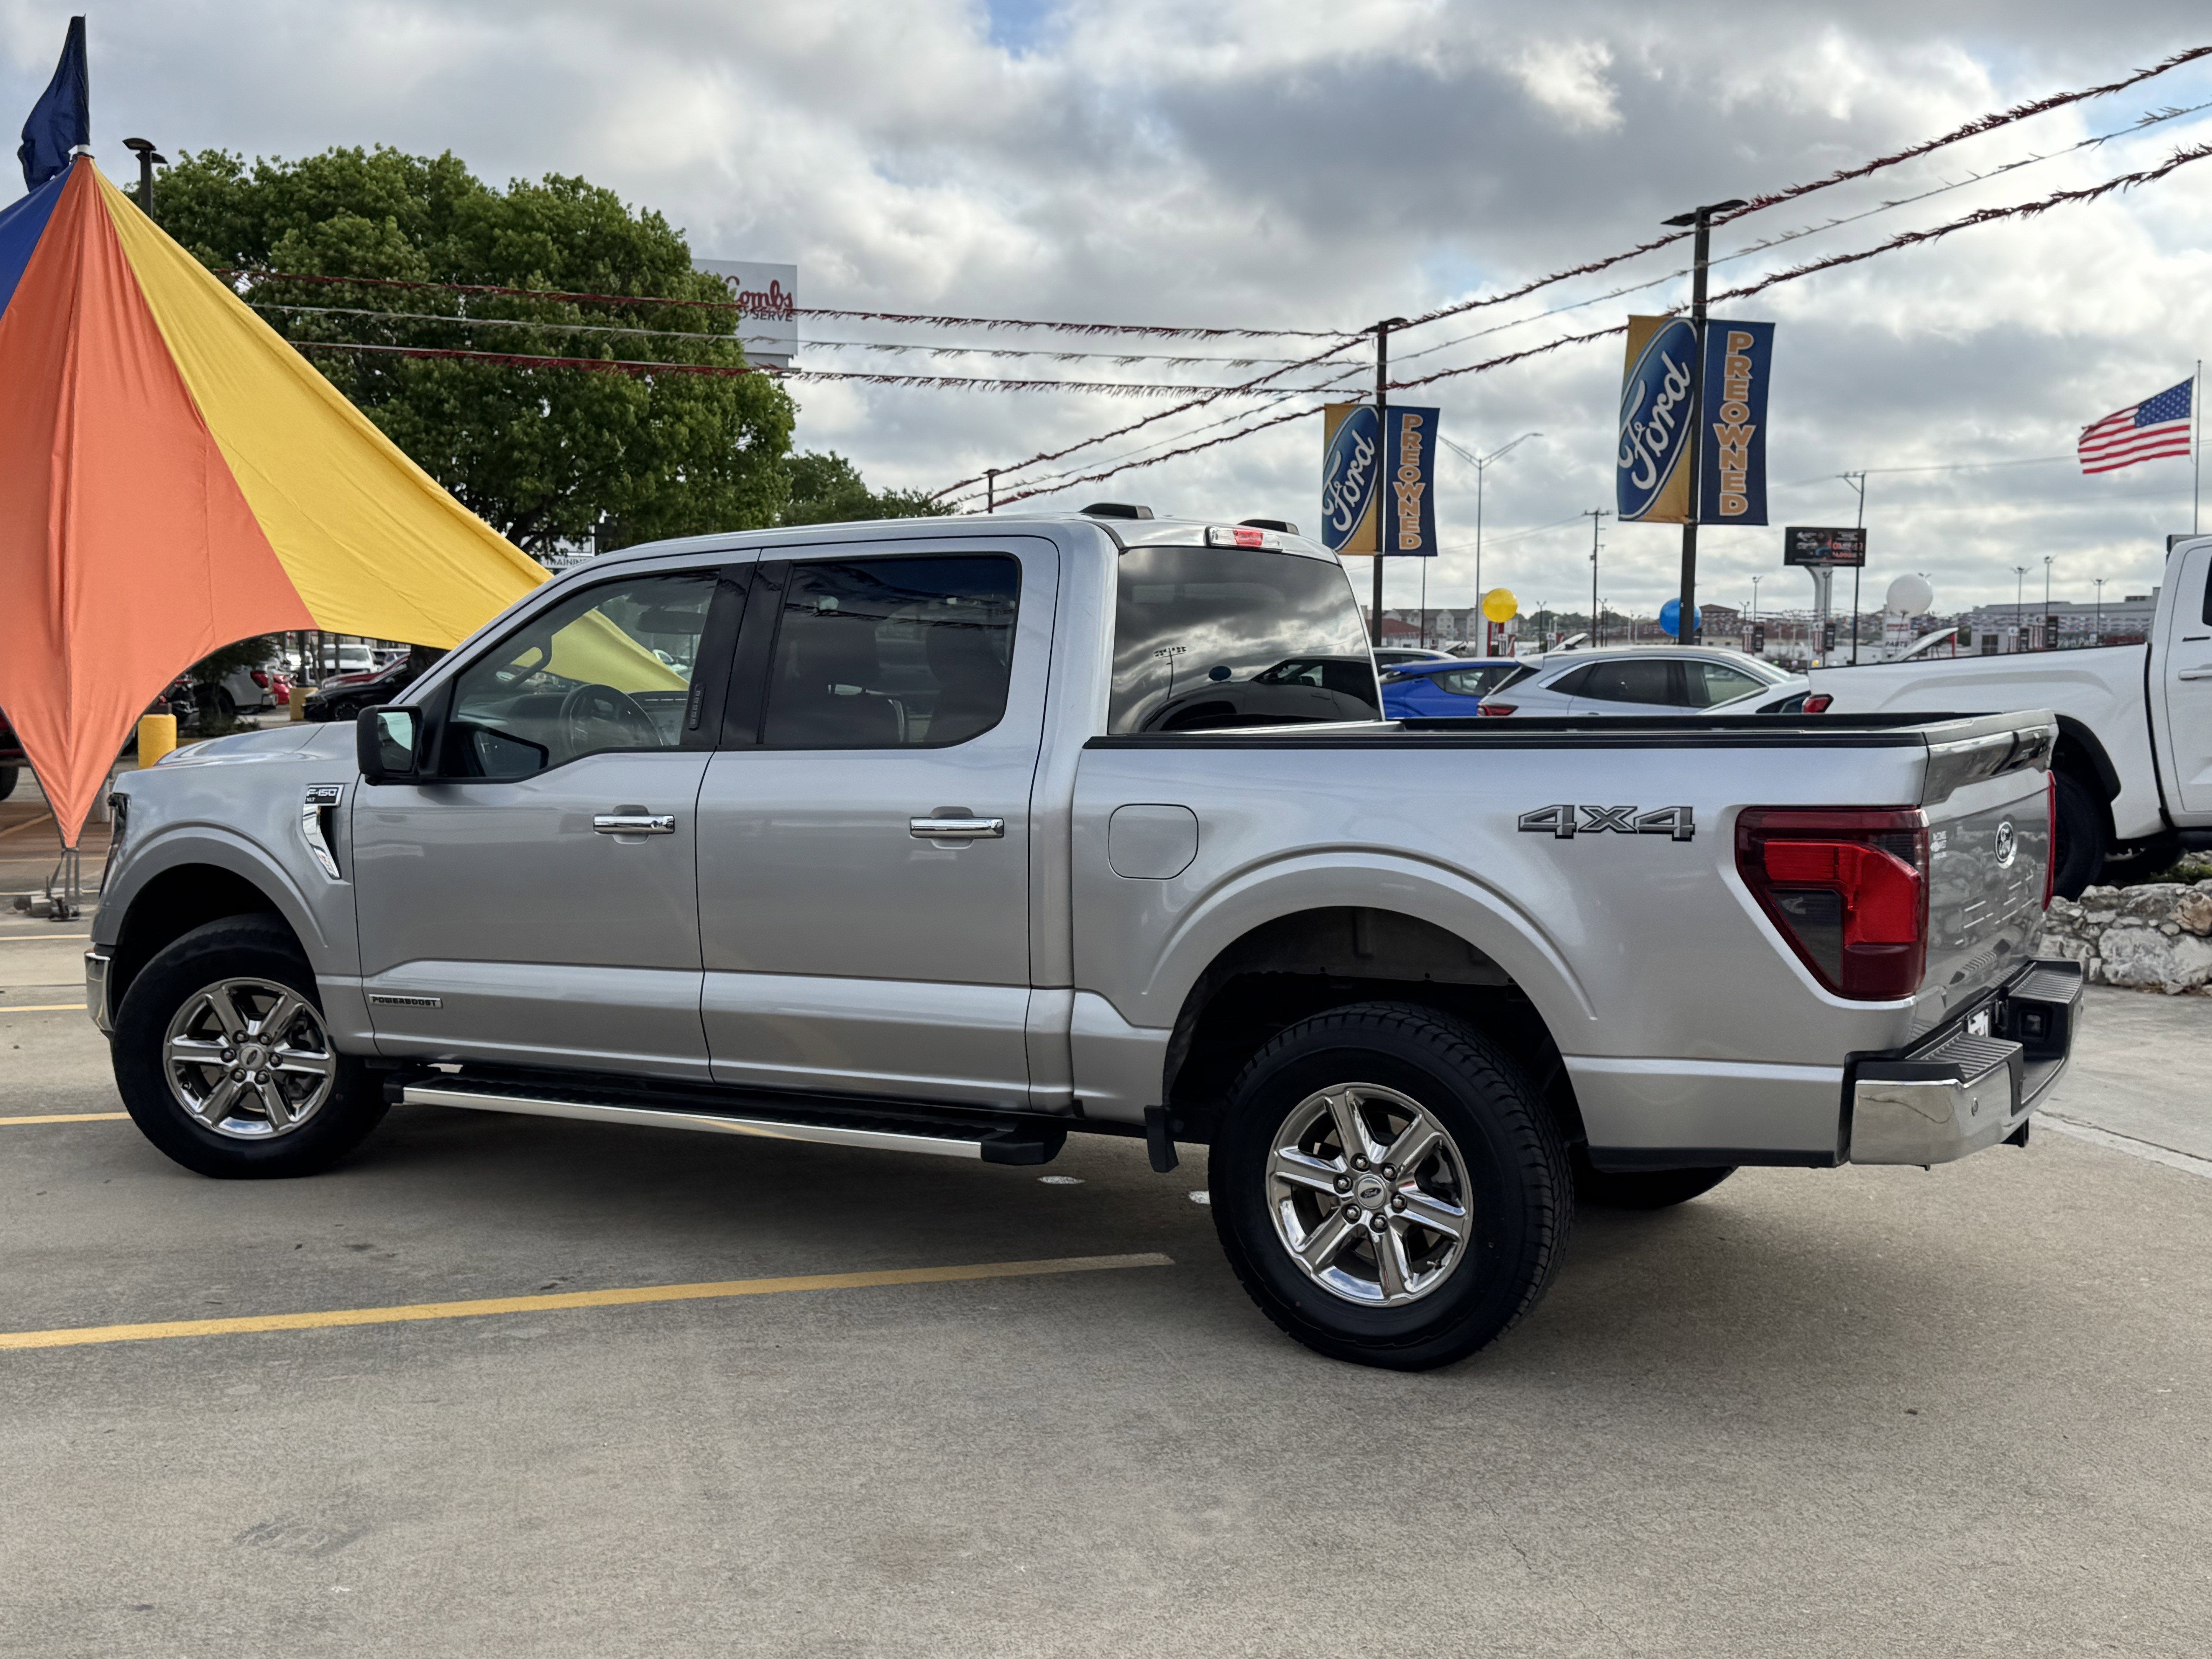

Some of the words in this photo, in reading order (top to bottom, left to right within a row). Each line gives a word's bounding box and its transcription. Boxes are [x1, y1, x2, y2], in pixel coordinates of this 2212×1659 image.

[1617, 350, 1691, 490] Ford
[1322, 428, 1376, 532] Ford
[307, 788, 337, 797] F-150
